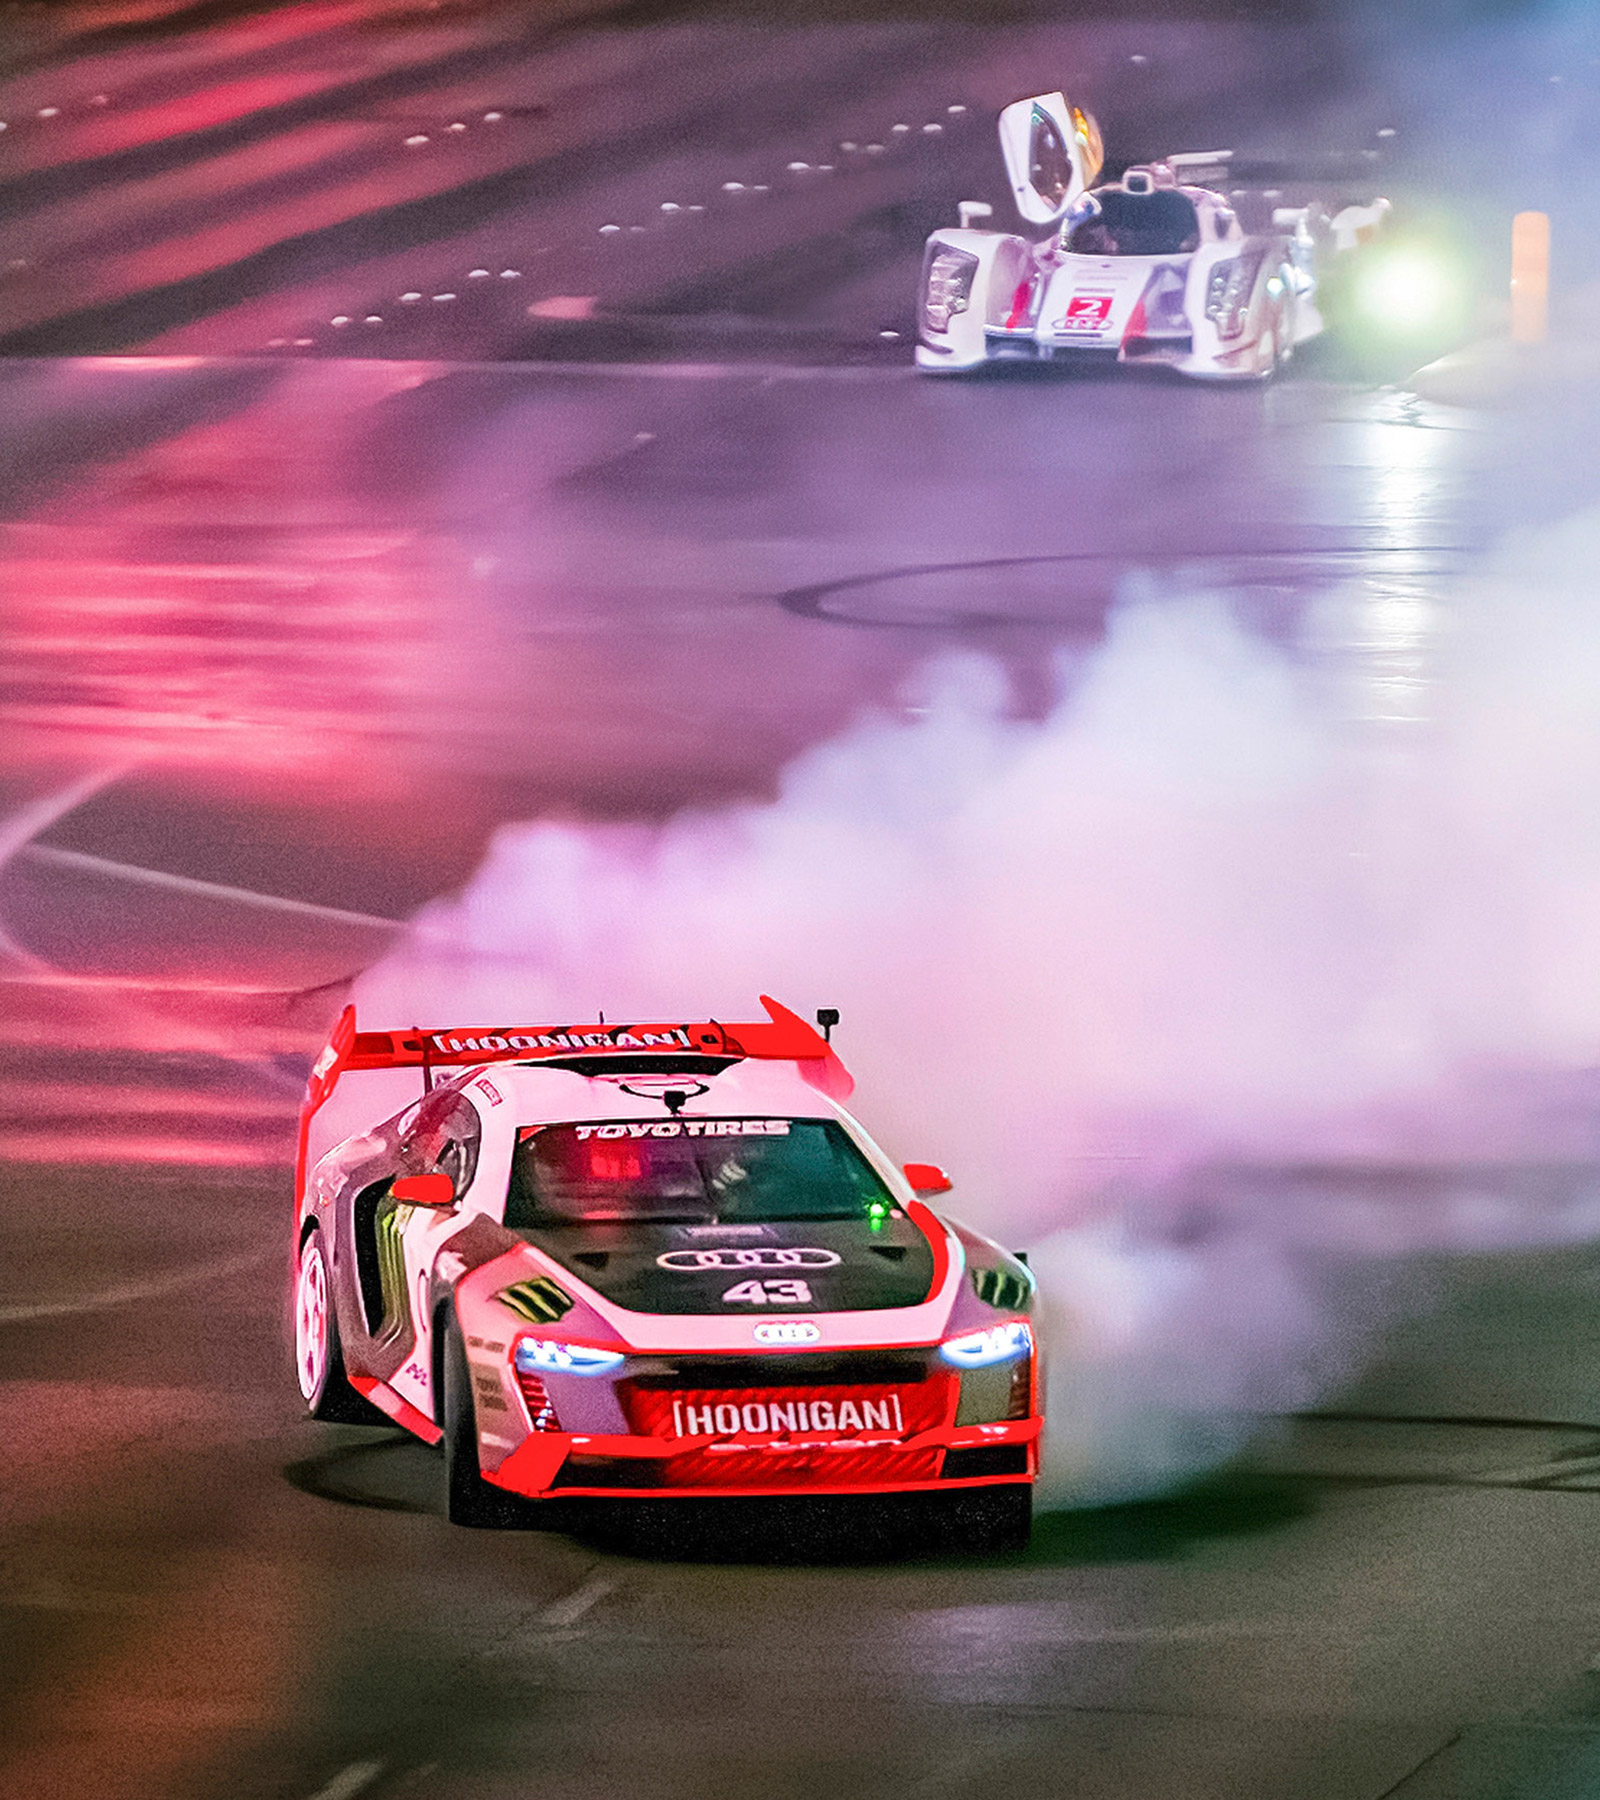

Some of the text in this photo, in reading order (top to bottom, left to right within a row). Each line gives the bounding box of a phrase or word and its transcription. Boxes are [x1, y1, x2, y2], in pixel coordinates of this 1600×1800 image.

[1075, 300, 1103, 316] 2
[575, 1120, 792, 1140] TOYO TIRES
[722, 1279, 812, 1305] 43
